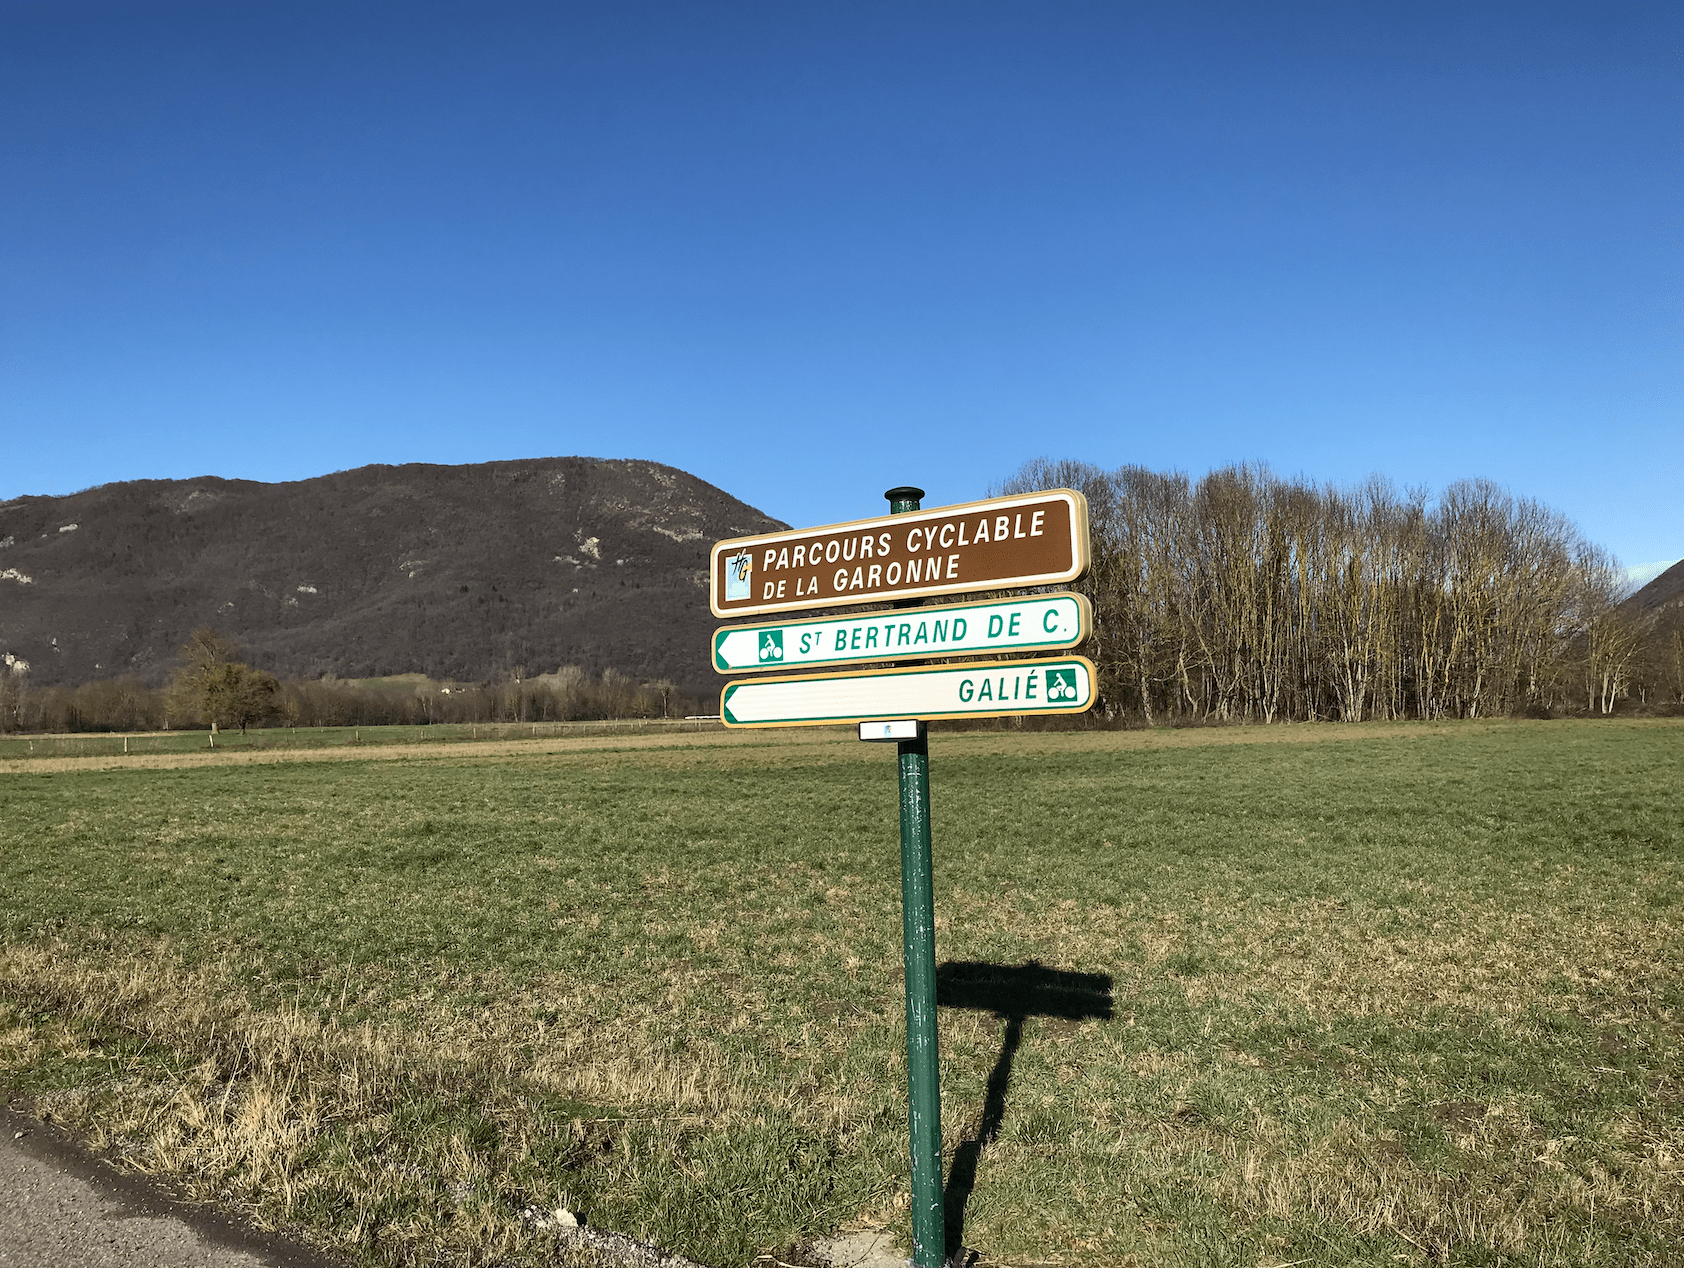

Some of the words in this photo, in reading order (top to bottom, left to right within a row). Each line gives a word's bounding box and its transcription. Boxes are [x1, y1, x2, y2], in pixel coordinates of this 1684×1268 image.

[763, 533, 892, 572] PARCOURS
[906, 510, 1045, 553] CYCLABLE
[763, 580, 787, 600] DE
[796, 576, 818, 596] LA
[833, 554, 960, 592] GARONNE
[835, 618, 967, 651] BERTRAND
[987, 612, 1021, 639] DE
[1043, 609, 1067, 634] C.
[959, 669, 1038, 703] GALIÉ
